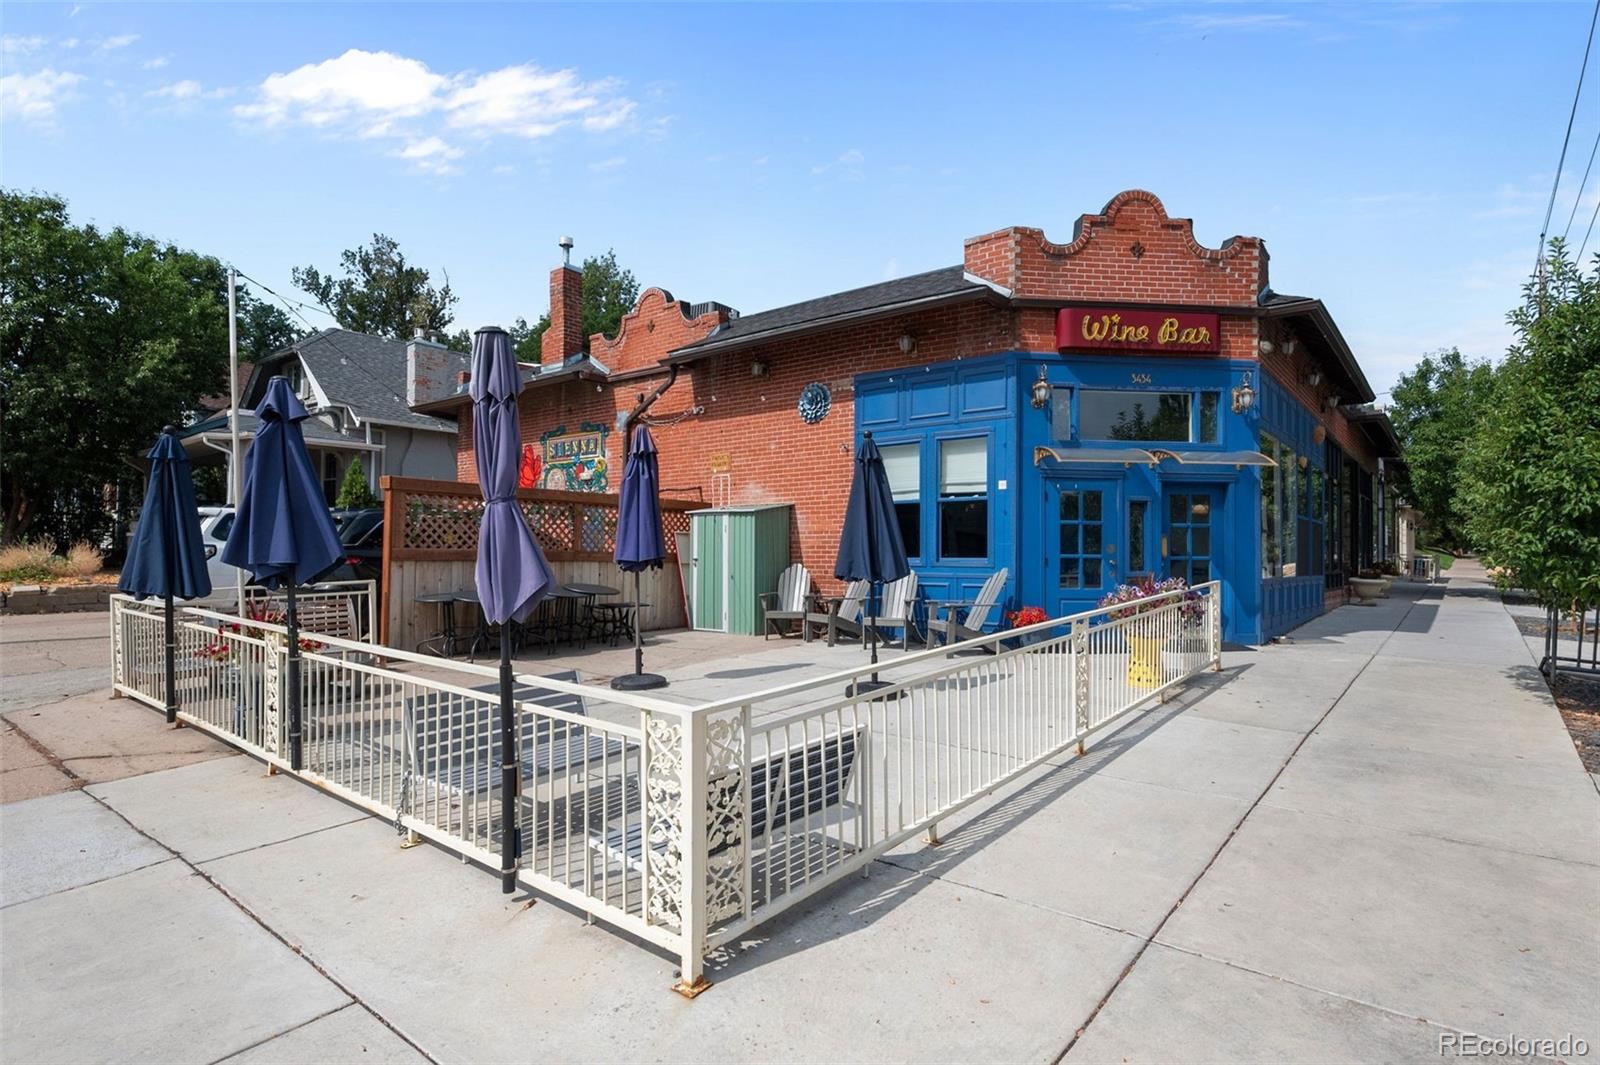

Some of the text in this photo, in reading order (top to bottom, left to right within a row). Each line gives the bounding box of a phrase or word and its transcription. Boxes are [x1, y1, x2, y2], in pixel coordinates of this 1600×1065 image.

[1081, 313, 1211, 344] Wine Bar
[549, 438, 597, 457] SIENNA
